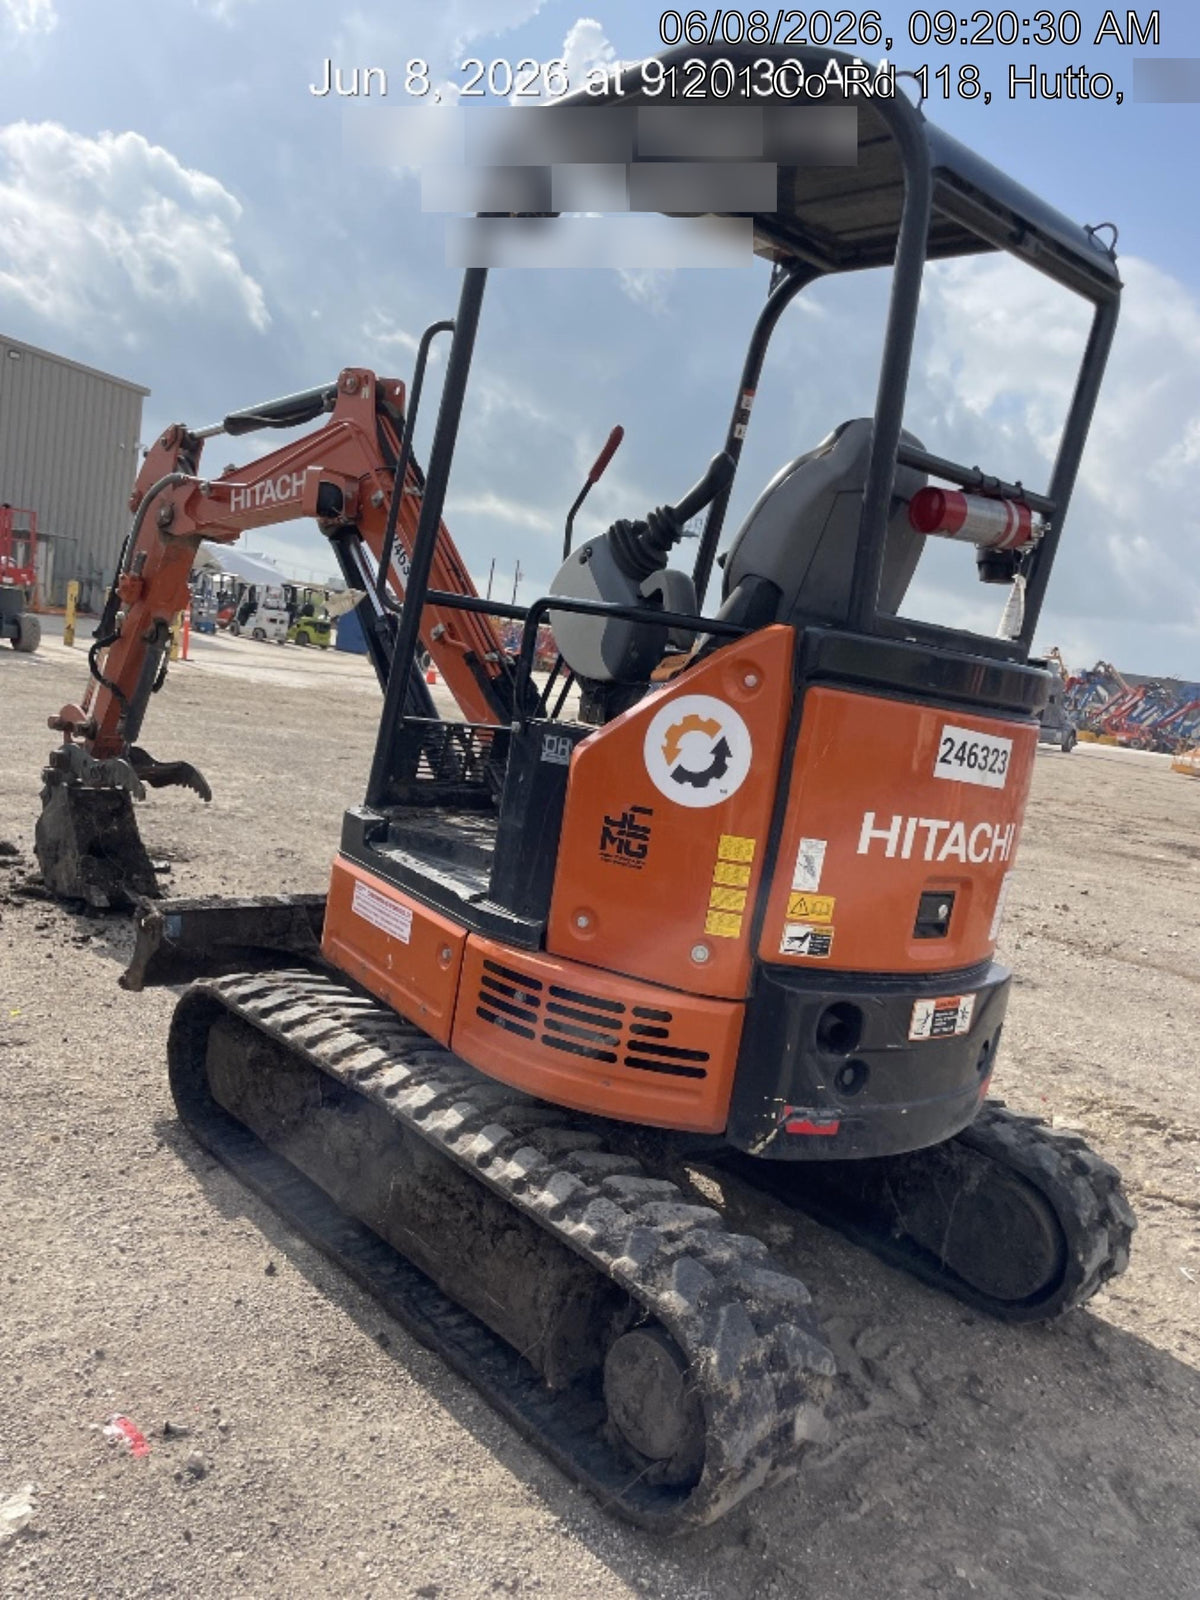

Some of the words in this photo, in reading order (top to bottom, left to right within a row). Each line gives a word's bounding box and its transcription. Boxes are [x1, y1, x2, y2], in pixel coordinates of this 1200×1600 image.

[230, 468, 306, 512] HITACH
[939, 737, 1009, 775] 246323
[856, 811, 1016, 863] HITACHI
